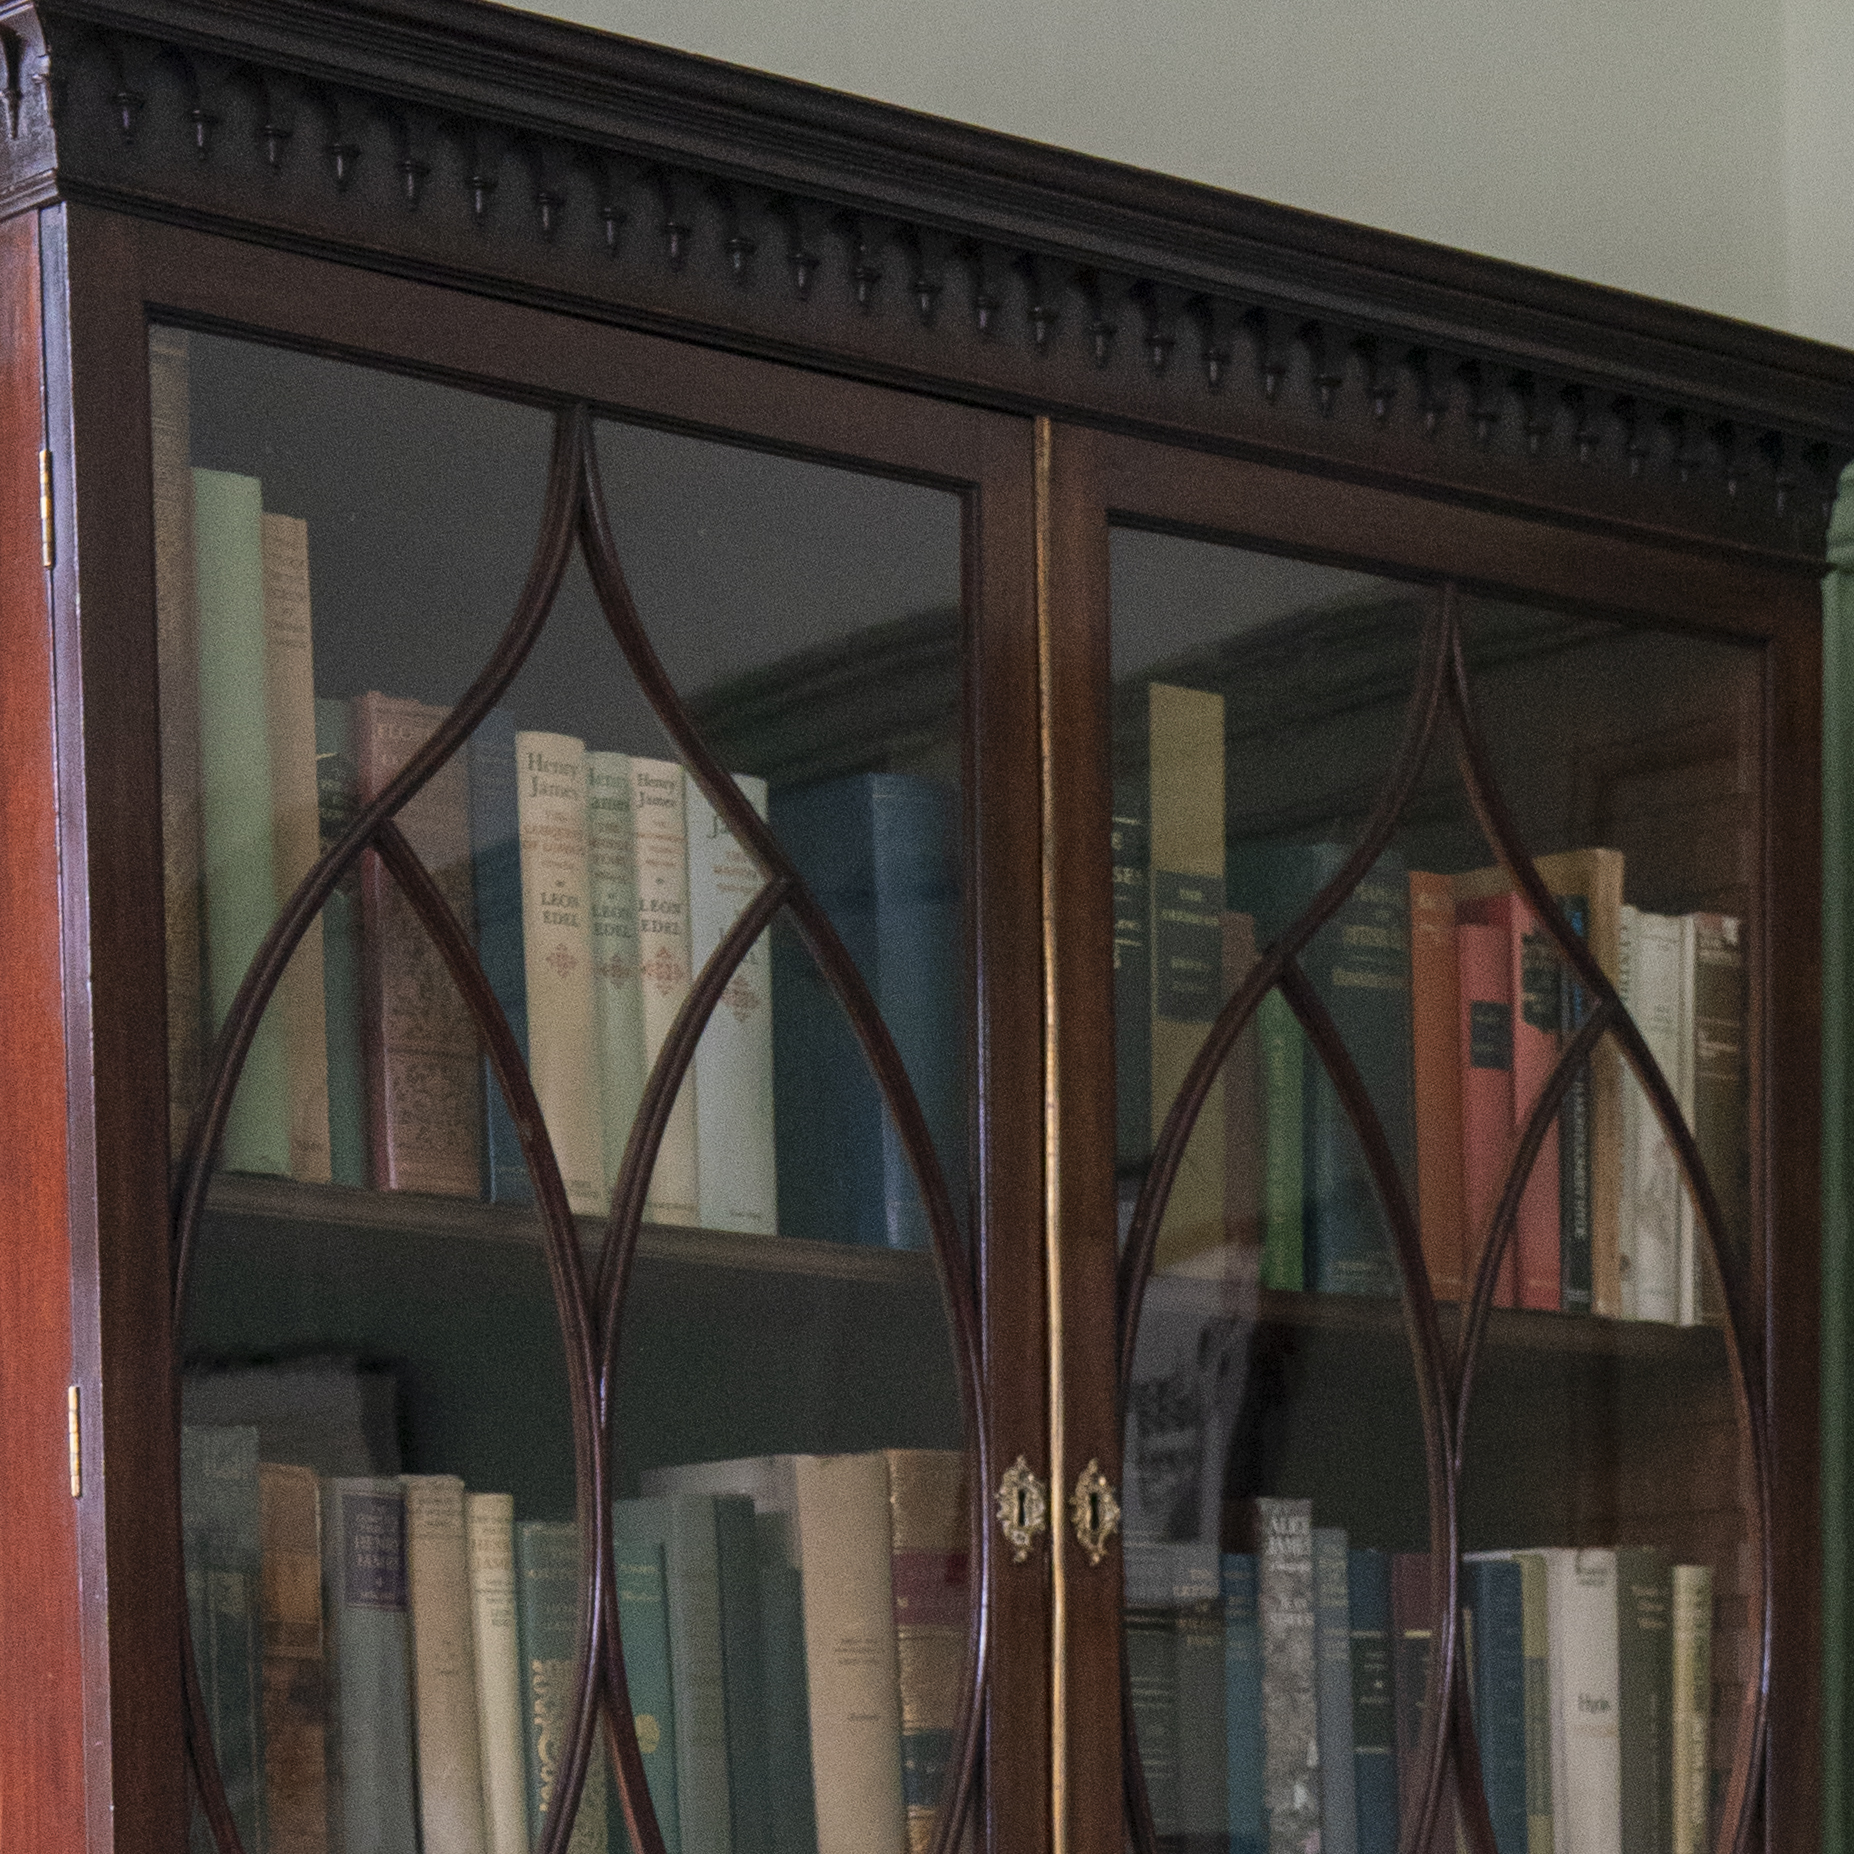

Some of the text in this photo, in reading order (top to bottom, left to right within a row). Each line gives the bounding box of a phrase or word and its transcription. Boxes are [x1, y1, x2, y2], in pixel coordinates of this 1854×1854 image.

[528, 752, 580, 781] Henry
[529, 775, 579, 801] James
[637, 773, 676, 795] Henry
[637, 791, 676, 808] James
[540, 892, 580, 908] LEON
[638, 899, 682, 914] LEON
[543, 910, 580, 927] EDEL
[640, 919, 681, 935] EDEL
